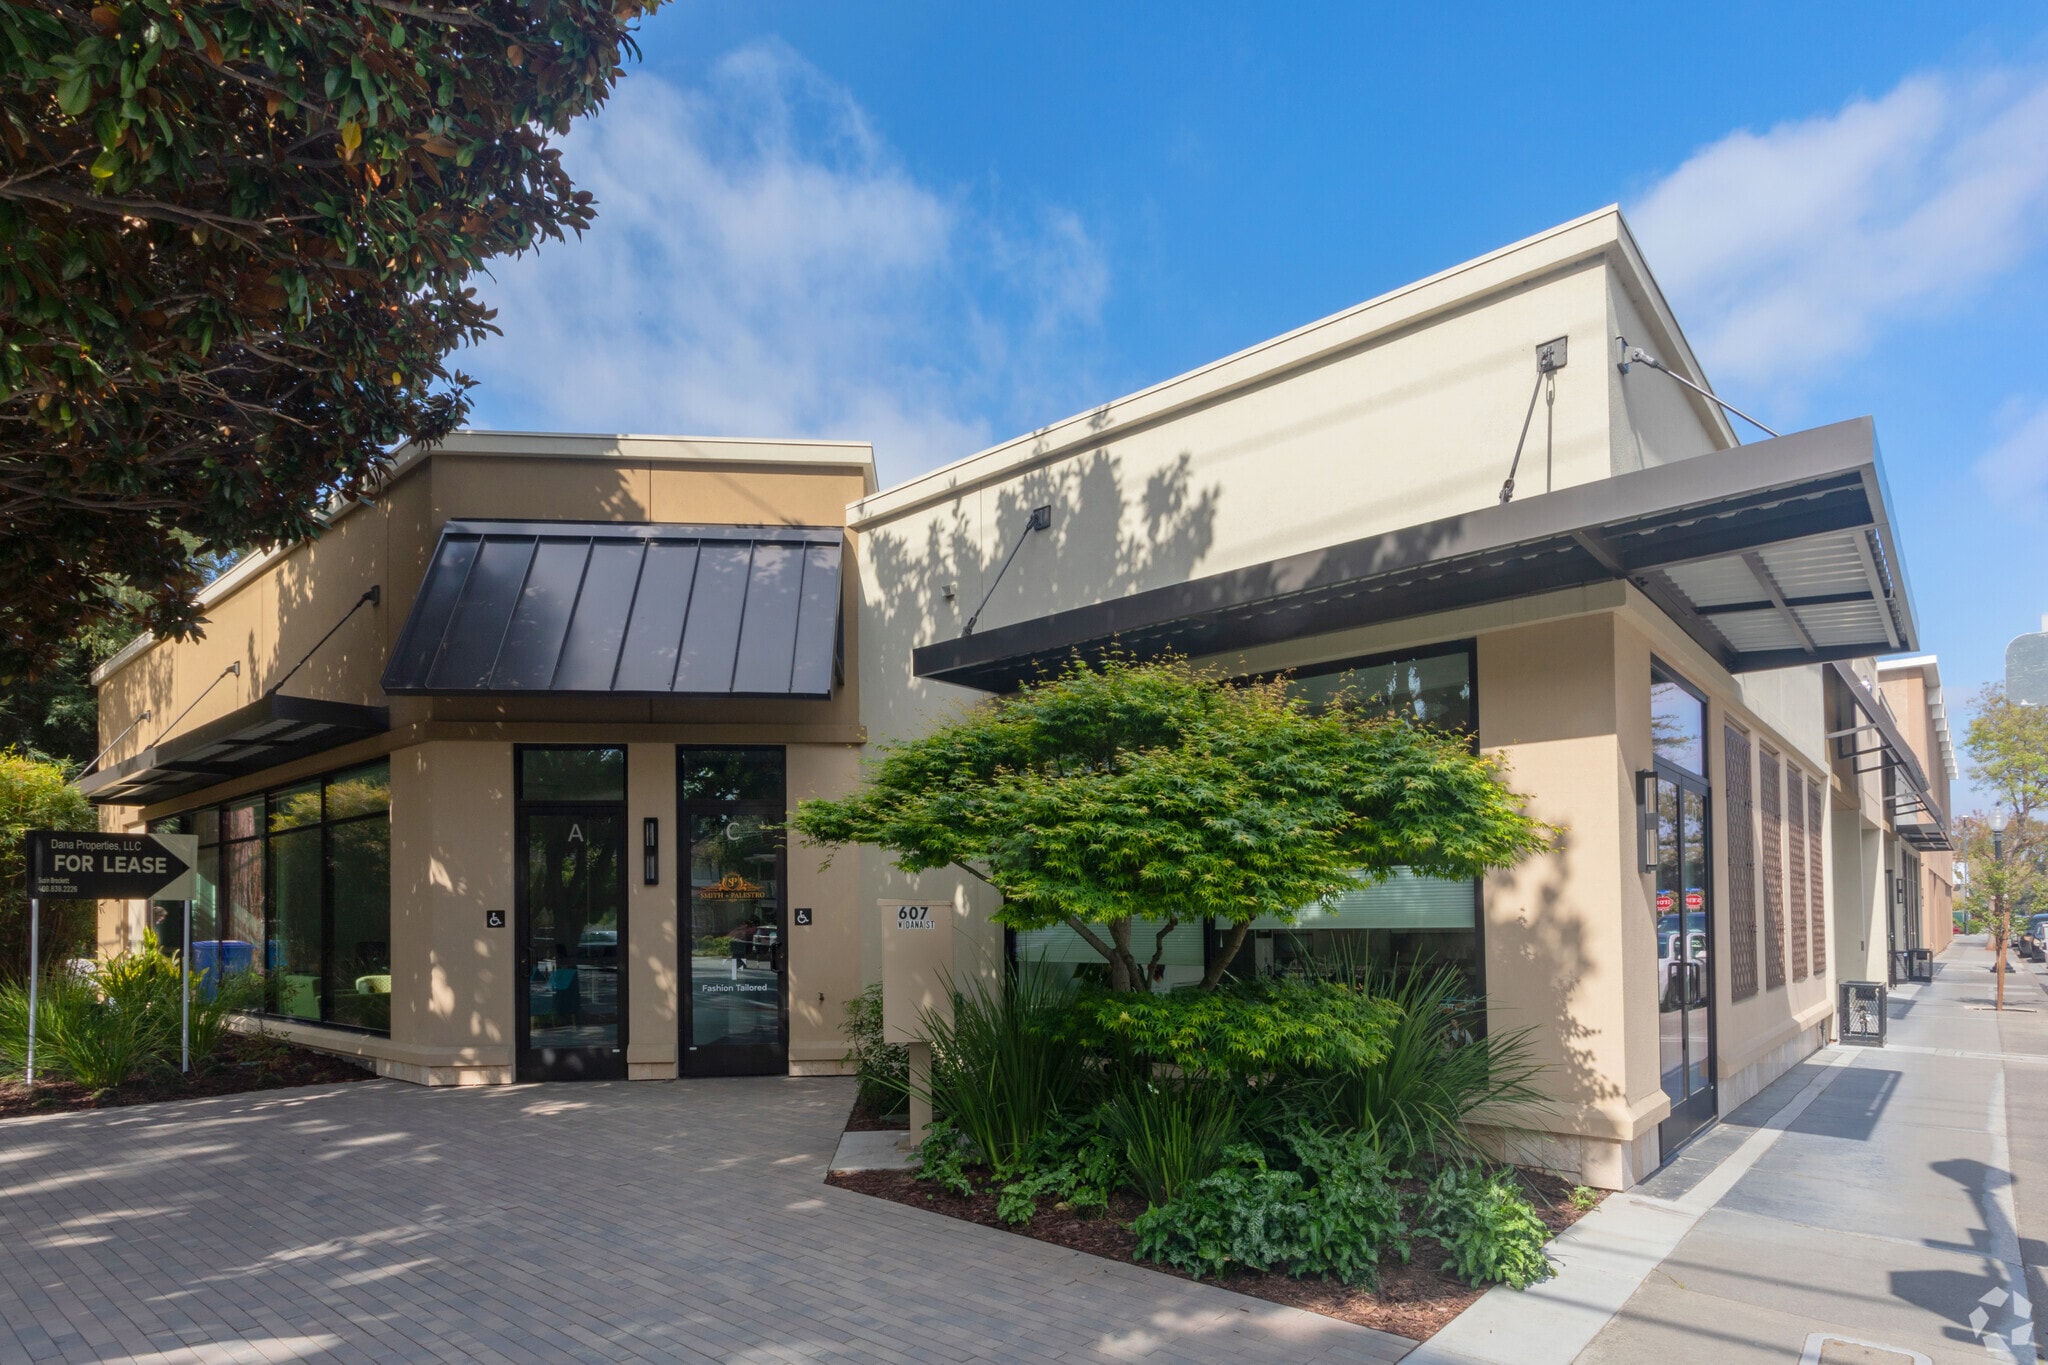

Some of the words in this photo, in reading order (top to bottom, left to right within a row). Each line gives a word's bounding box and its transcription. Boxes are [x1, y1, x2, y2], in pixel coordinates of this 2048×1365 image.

[568, 824, 584, 842] A
[726, 823, 740, 841] C
[51, 839, 74, 849] Dana
[76, 840, 121, 852] Properties,
[123, 841, 142, 851] LLC
[54, 854, 94, 872] FOR
[103, 856, 167, 873] LEASE
[899, 906, 928, 920] 607
[906, 921, 924, 929] DANA
[926, 921, 935, 929] ST
[702, 984, 734, 992] Fashion
[736, 983, 768, 992] Tailored
